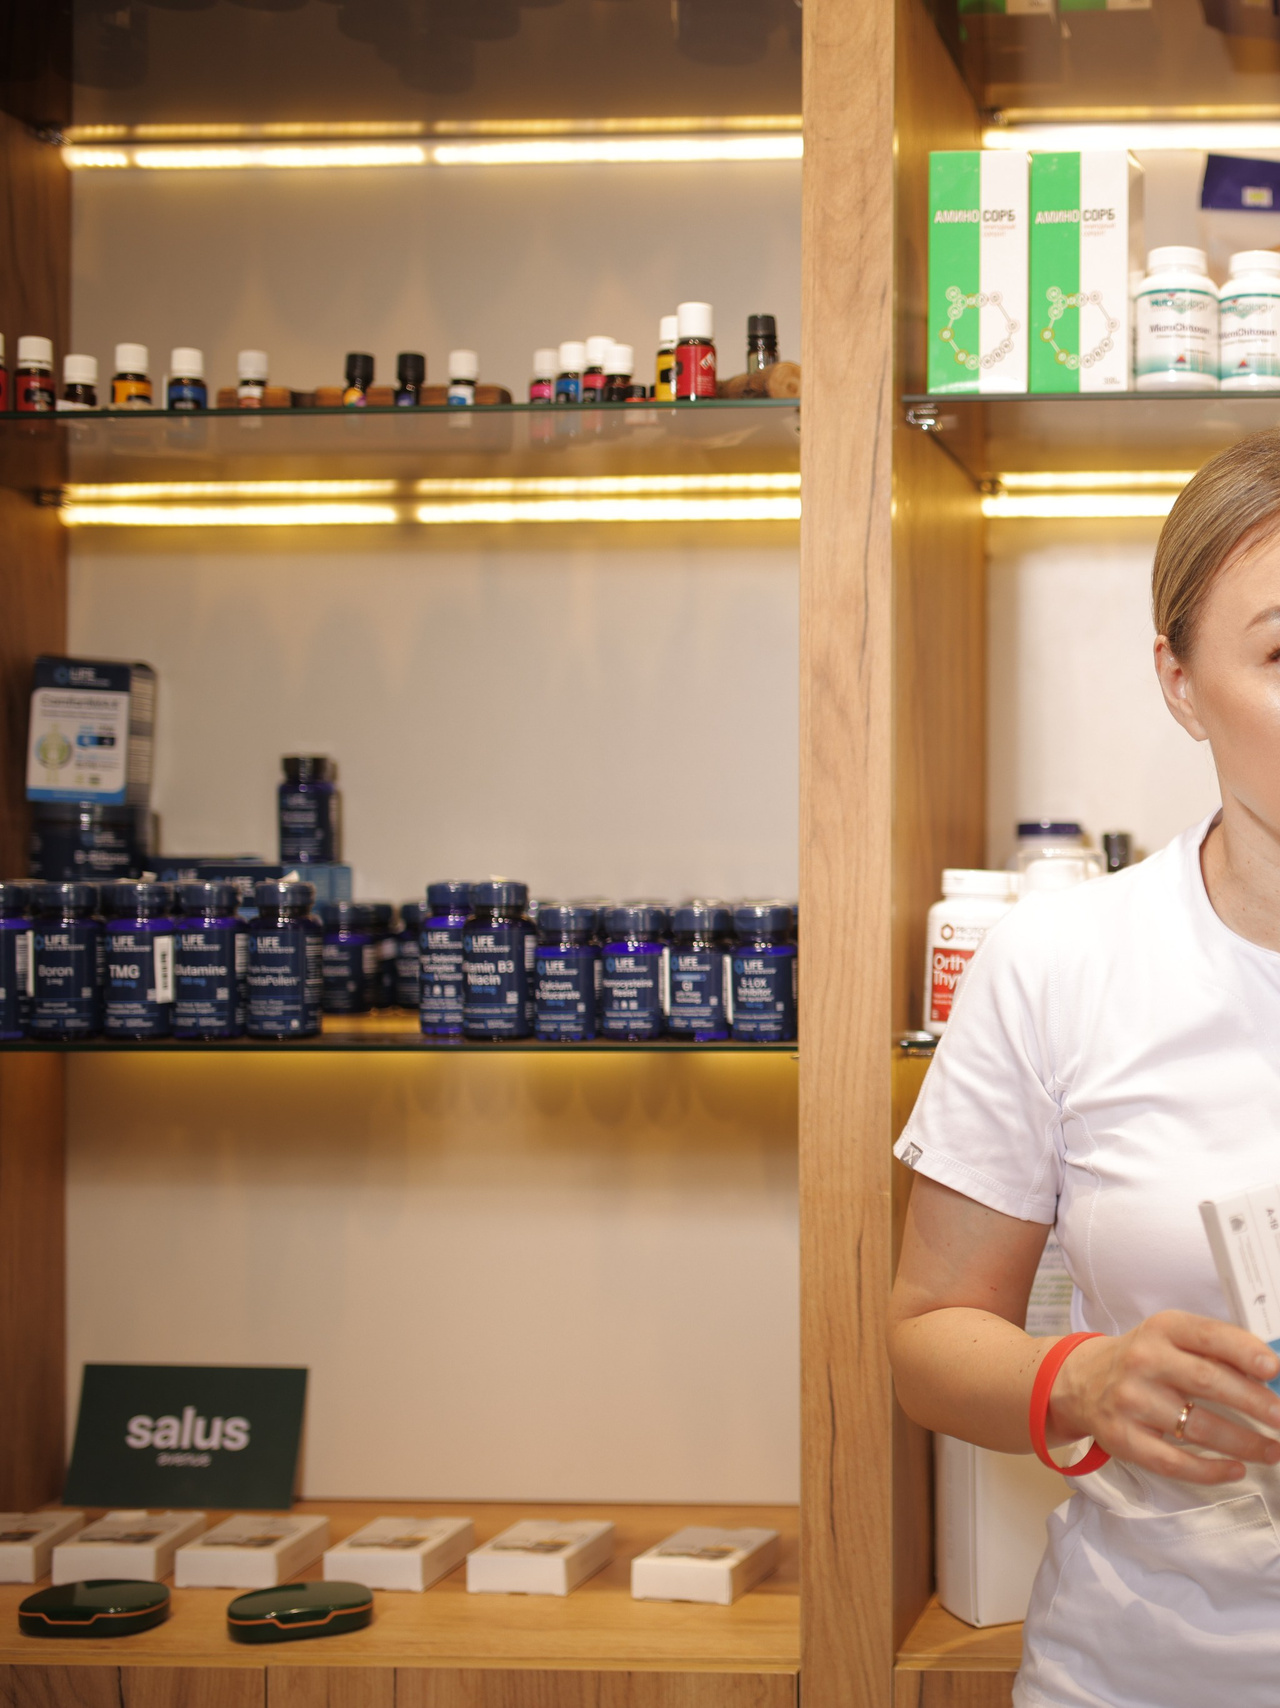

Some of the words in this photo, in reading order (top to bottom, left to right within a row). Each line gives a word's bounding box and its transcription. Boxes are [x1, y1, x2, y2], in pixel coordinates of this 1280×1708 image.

[934, 210, 979, 223] АМИНО
[983, 210, 1015, 222] СОРБ
[1035, 210, 1080, 224] АМИНО
[1083, 208, 1115, 222] СОРБ
[472, 935, 495, 948] LIFE
[109, 964, 141, 979] TMG
[126, 1405, 250, 1451] salus
